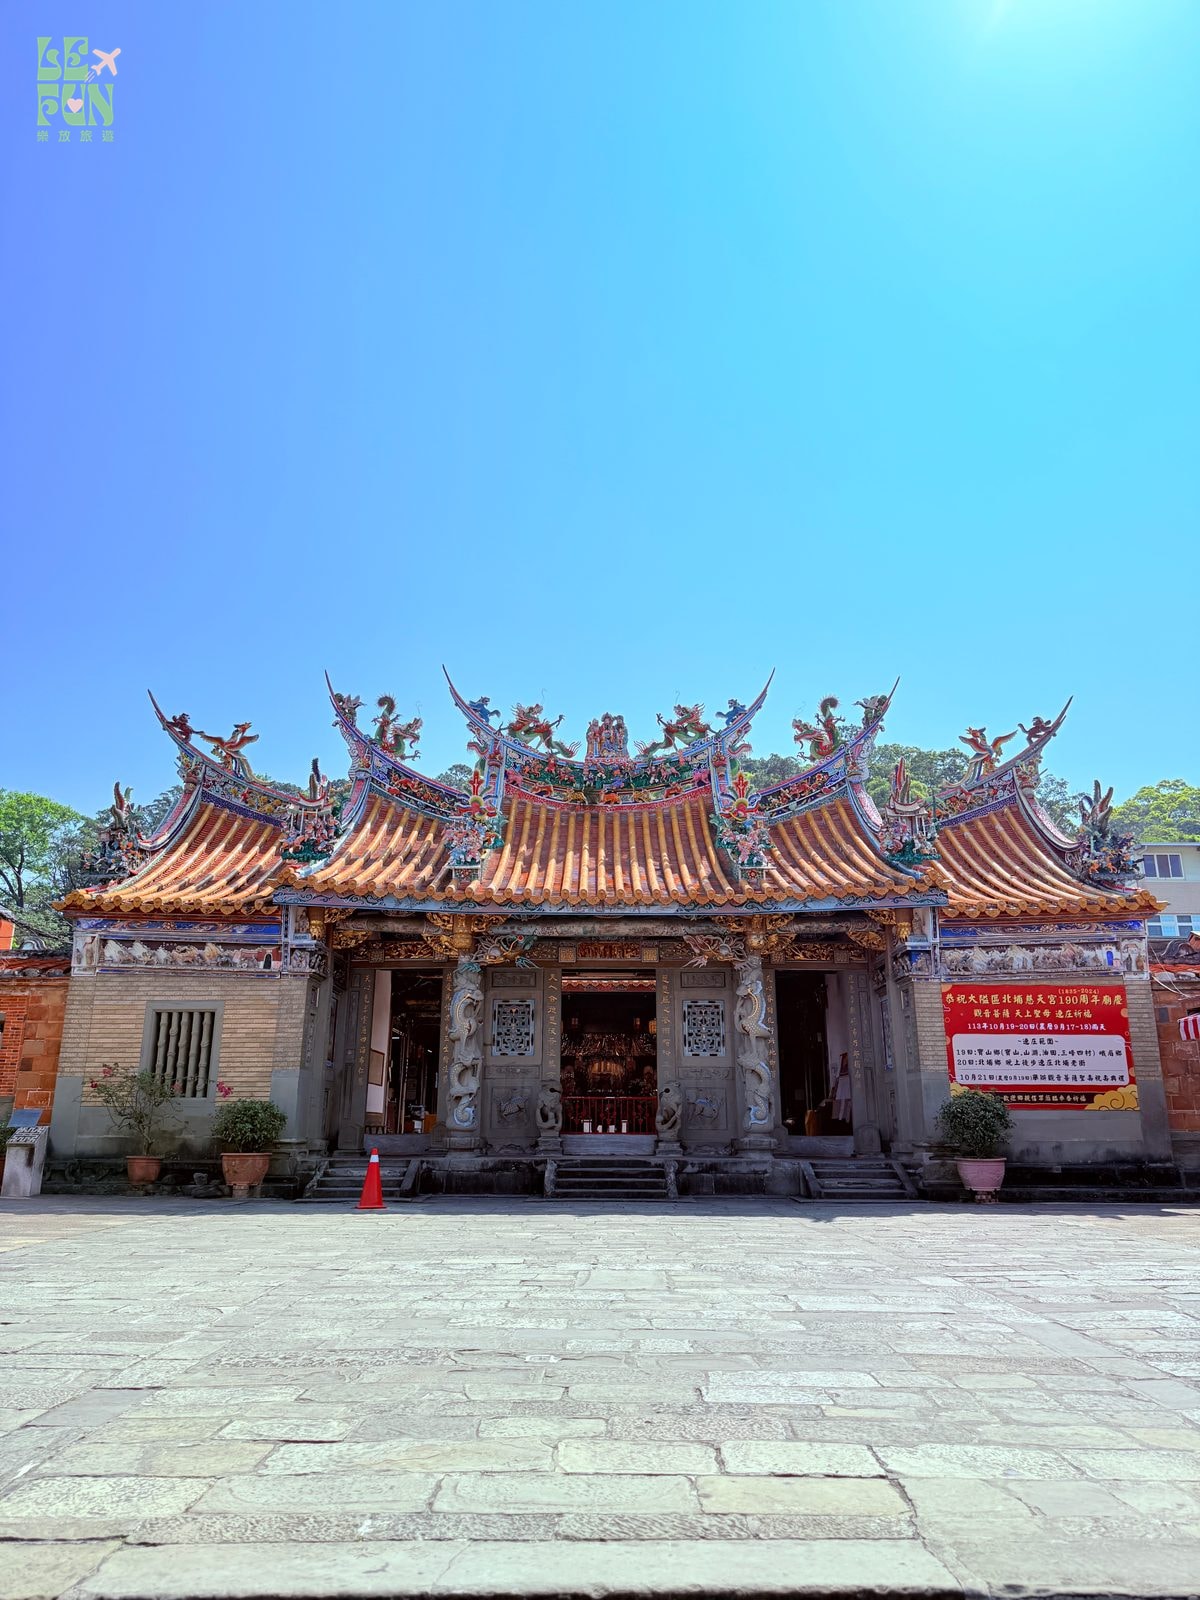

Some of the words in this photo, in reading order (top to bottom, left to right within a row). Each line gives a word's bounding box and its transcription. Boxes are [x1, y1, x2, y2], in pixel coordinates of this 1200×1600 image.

[973, 1008, 1010, 1018] 觀音菩薩
[1015, 1009, 1051, 1018] 天上聖母
